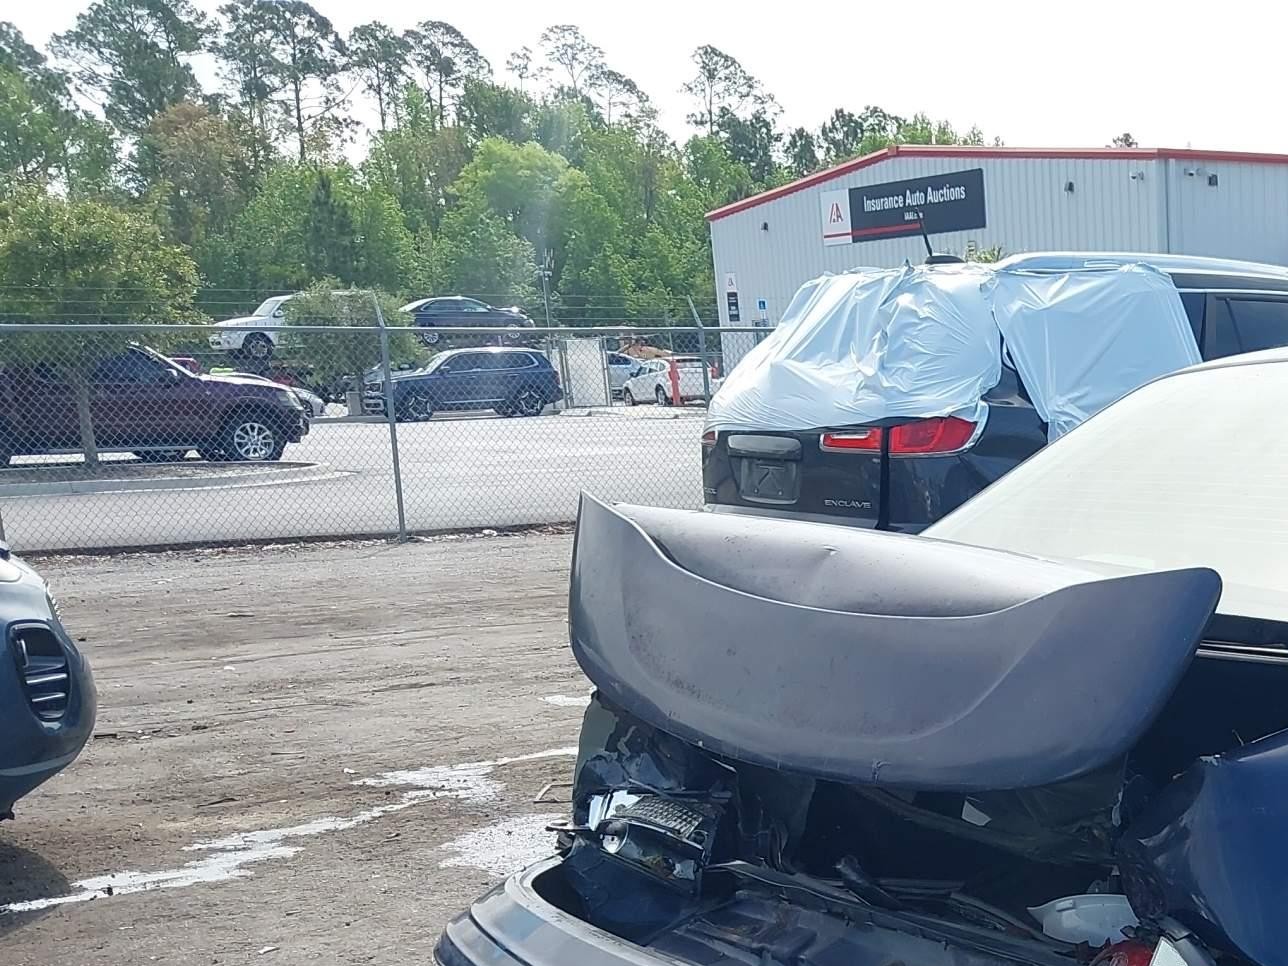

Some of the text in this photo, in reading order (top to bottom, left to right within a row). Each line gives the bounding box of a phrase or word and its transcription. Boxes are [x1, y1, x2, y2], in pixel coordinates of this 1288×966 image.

[863, 183, 966, 212] Insurance Auto Auctions
[824, 499, 872, 509] ENCLAVE
